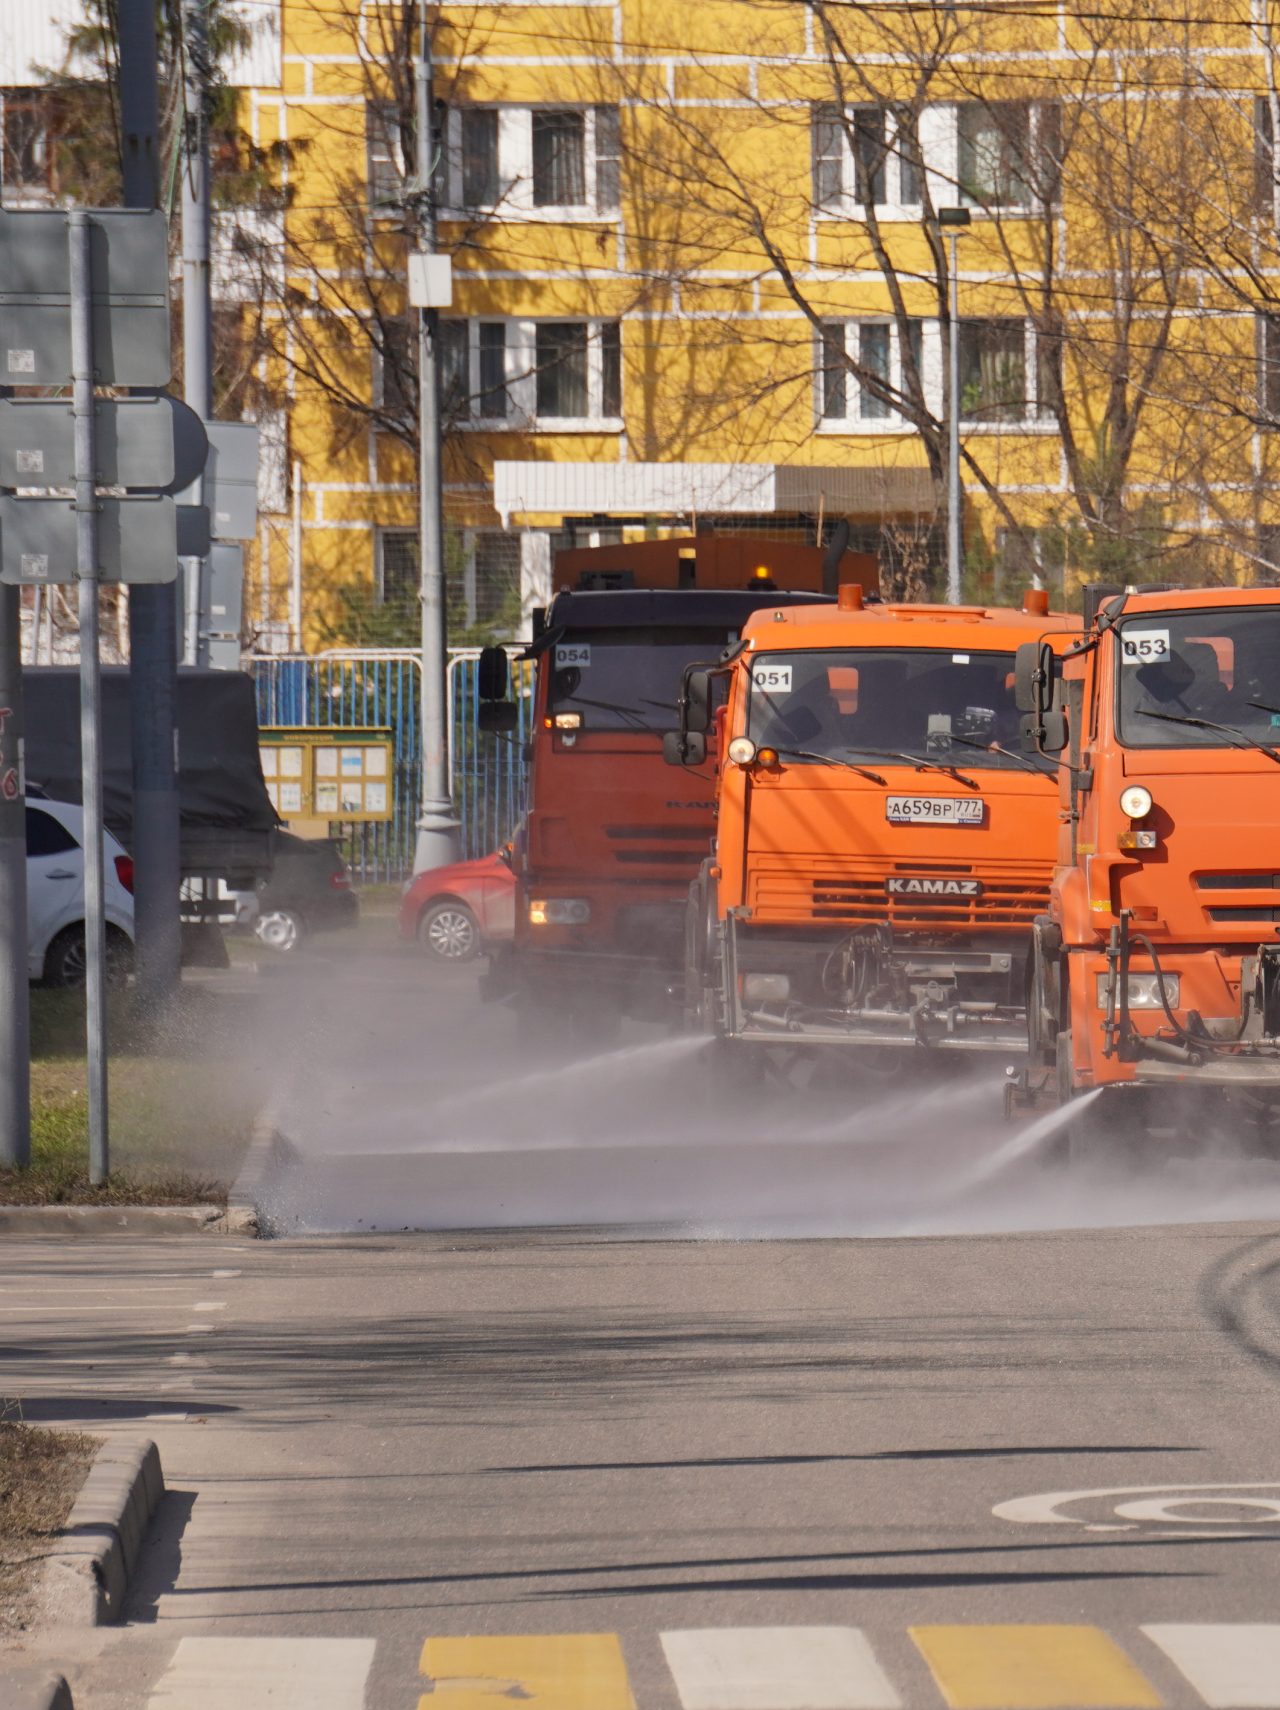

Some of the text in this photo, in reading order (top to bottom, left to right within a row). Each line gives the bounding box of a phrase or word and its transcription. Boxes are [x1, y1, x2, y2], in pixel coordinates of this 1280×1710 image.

[1124, 638, 1167, 656] 053
[557, 649, 590, 662] 054
[755, 672, 790, 686] 051
[955, 800, 978, 813] 777
[888, 879, 978, 895] KAMAZ
